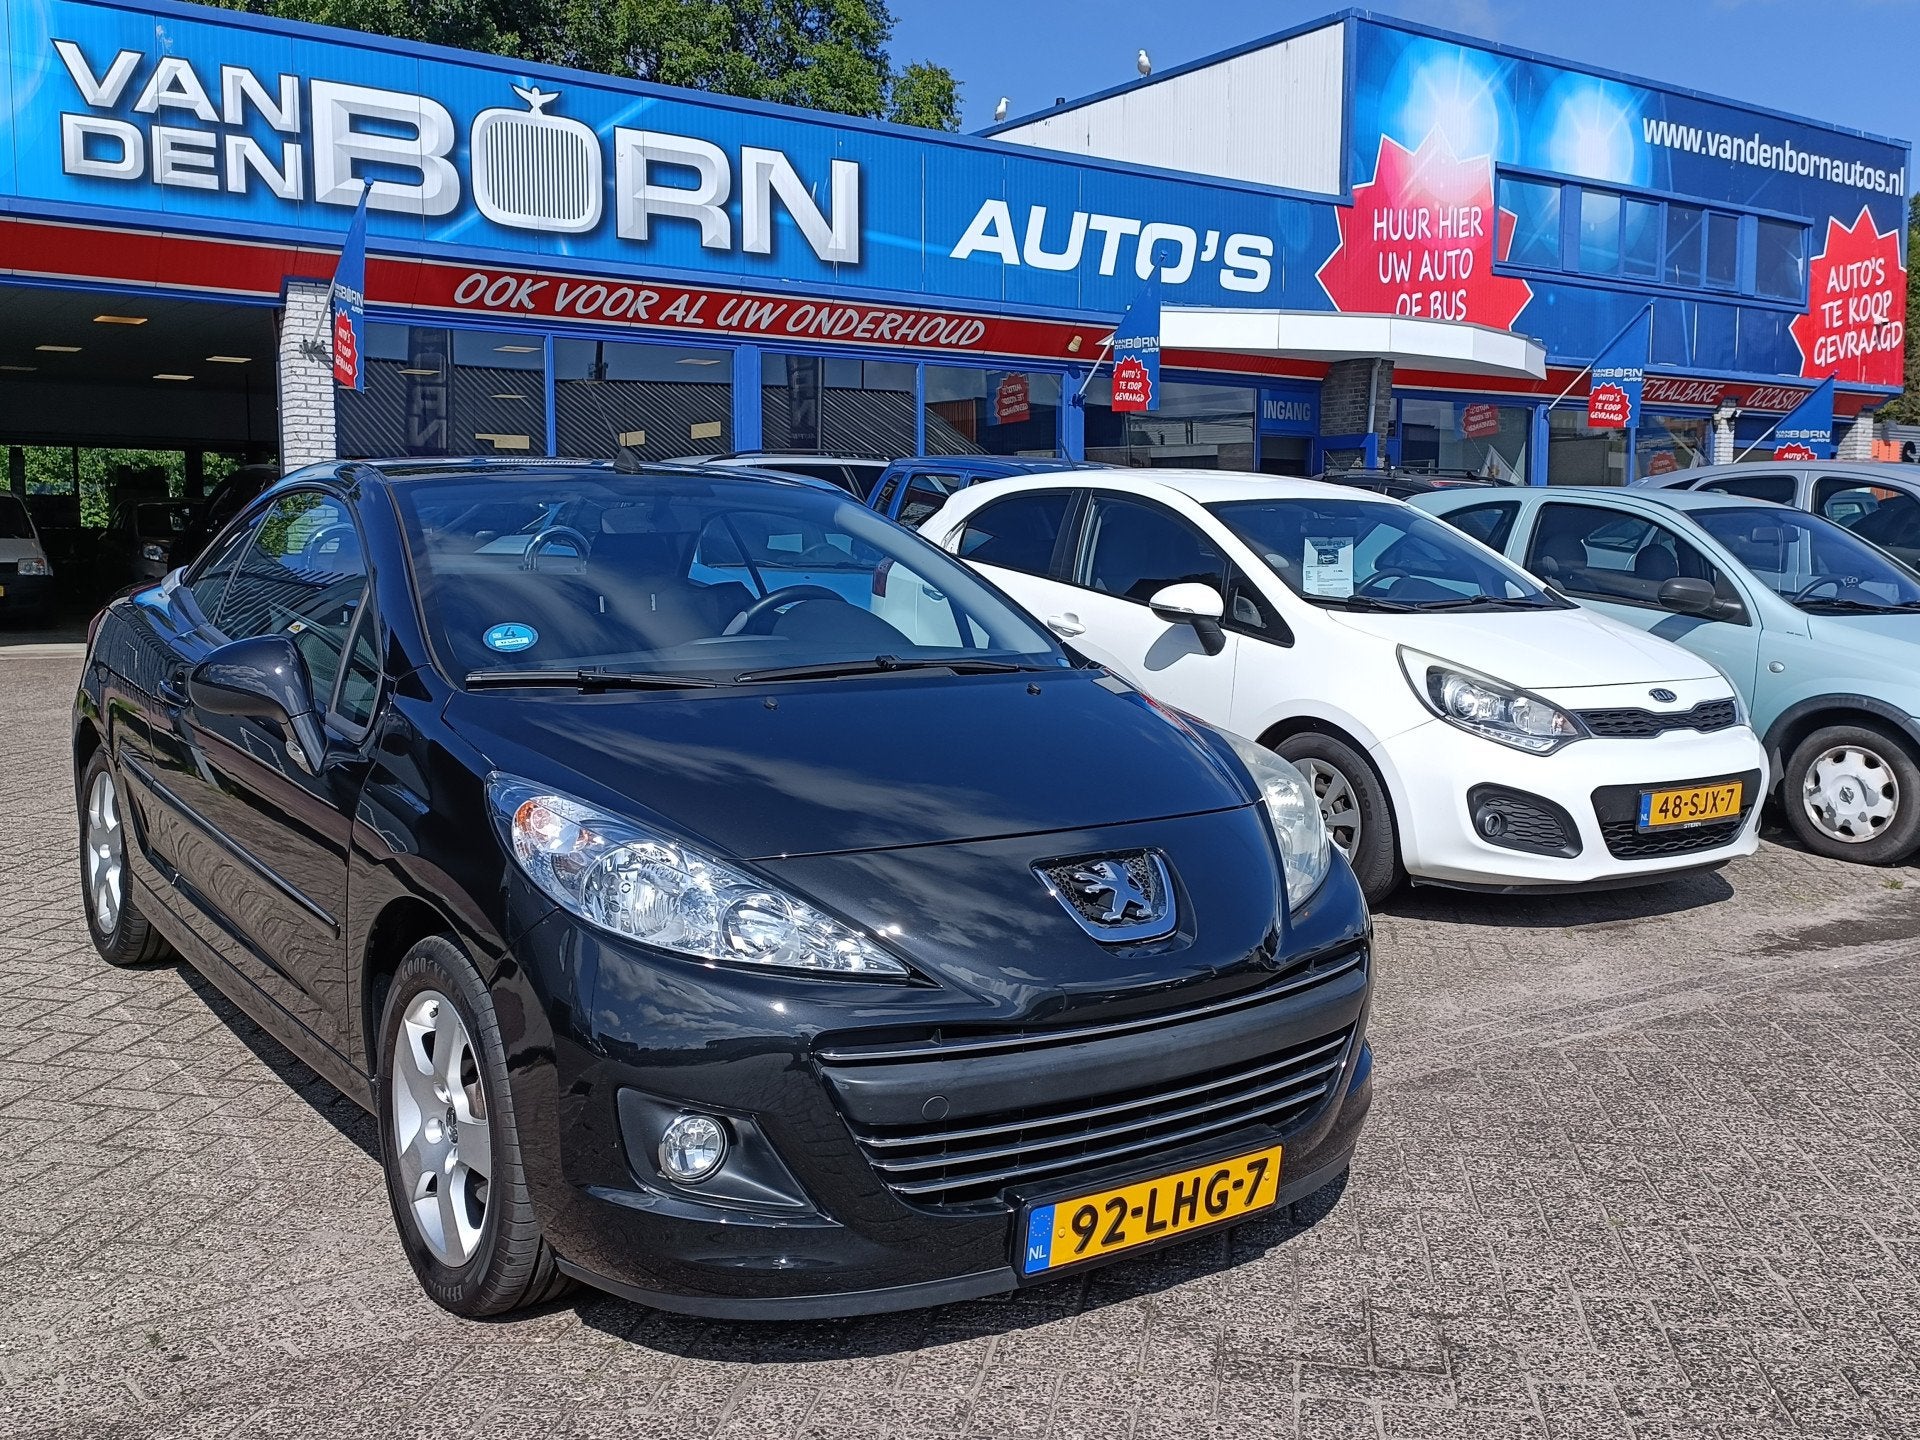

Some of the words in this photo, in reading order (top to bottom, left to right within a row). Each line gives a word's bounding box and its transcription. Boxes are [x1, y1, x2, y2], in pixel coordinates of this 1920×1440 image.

[51, 38, 300, 133] VAN
[61, 111, 303, 200] DEN
[309, 78, 860, 264] BORN
[1642, 117, 1905, 197] www.vandenbornautos.nl
[1373, 207, 1432, 241] HUUR
[1439, 205, 1484, 239] HIER
[949, 198, 1274, 293] AUTO'S
[1379, 250, 1412, 284] UW
[1418, 248, 1474, 281] AUTO
[1826, 257, 1885, 294] AUTO'S
[453, 273, 549, 310] OOK
[554, 283, 660, 320] VOOR
[659, 293, 708, 324] AL
[716, 298, 788, 330] UW
[786, 304, 986, 346] ONDERHOUD
[1395, 292, 1422, 317] OF
[1430, 289, 1467, 321] BUS
[1821, 299, 1843, 328] TE
[1849, 290, 1893, 325] KOOP
[1126, 336, 1159, 348] BORN
[1813, 321, 1903, 367] GEVRAAGD
[1119, 381, 1126, 389] TE
[1121, 369, 1141, 379] AUTO'S
[1605, 367, 1643, 378] BORN
[1115, 392, 1145, 402] GEVRAAGD
[1263, 400, 1311, 420] INGANG
[1595, 402, 1603, 410] TE
[1604, 403, 1621, 411] KOOP
[1598, 393, 1620, 402] AUTO'S
[1641, 378, 1725, 403] ETAALBARE
[1746, 388, 1809, 410] OCCASIO
[1590, 411, 1623, 421] GEVRAAGD
[1790, 429, 1830, 438] BORN
[1783, 452, 1808, 460] AUTO'S
[504, 627, 517, 638] 4
[1641, 813, 1649, 821] NL
[1658, 788, 1736, 820] 48-SJX-7
[1071, 1157, 1269, 1255] 92-LHG-7
[1028, 1245, 1047, 1262] NL
